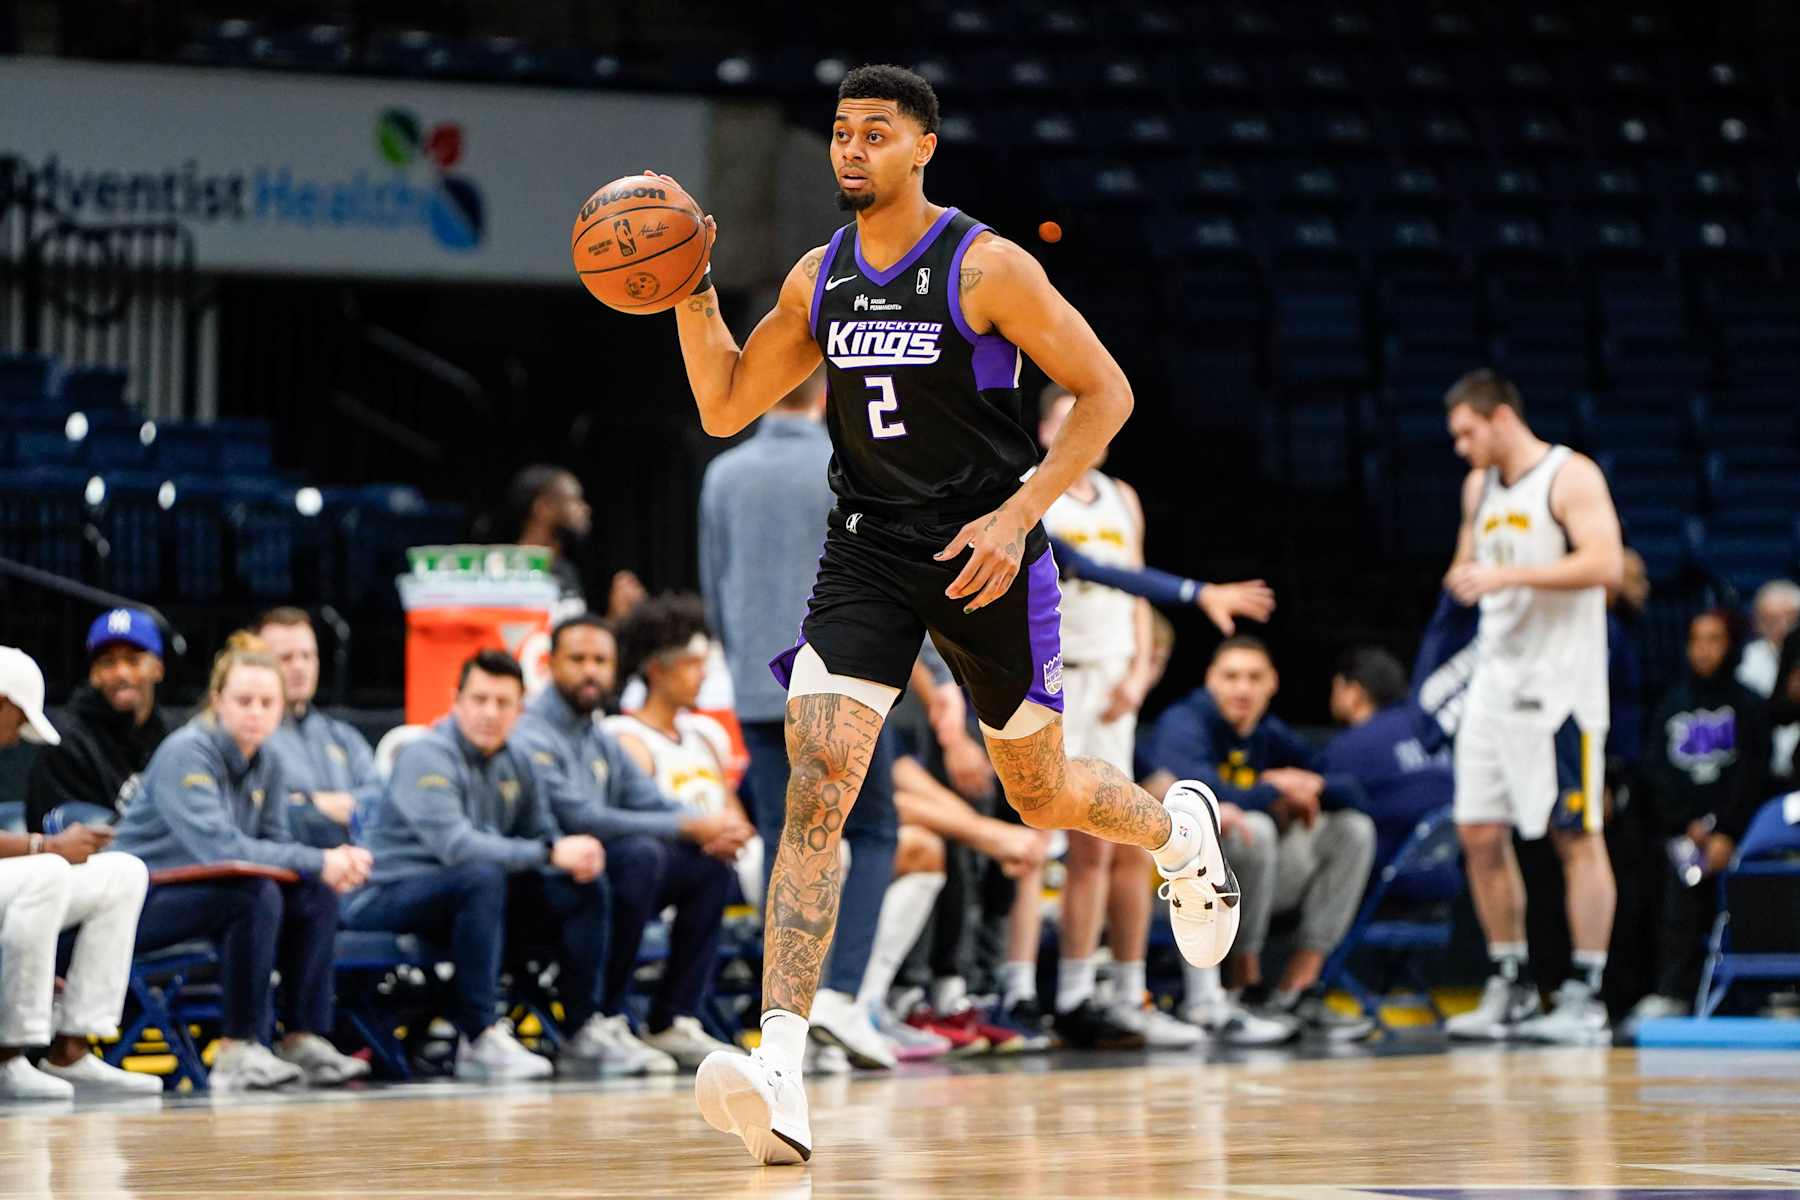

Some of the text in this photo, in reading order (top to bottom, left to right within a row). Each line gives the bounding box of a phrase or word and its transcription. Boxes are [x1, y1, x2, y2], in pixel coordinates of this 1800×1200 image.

[827, 321, 942, 368] Kings
[856, 320, 943, 333] STOCKTON
[864, 376, 906, 438] 2
